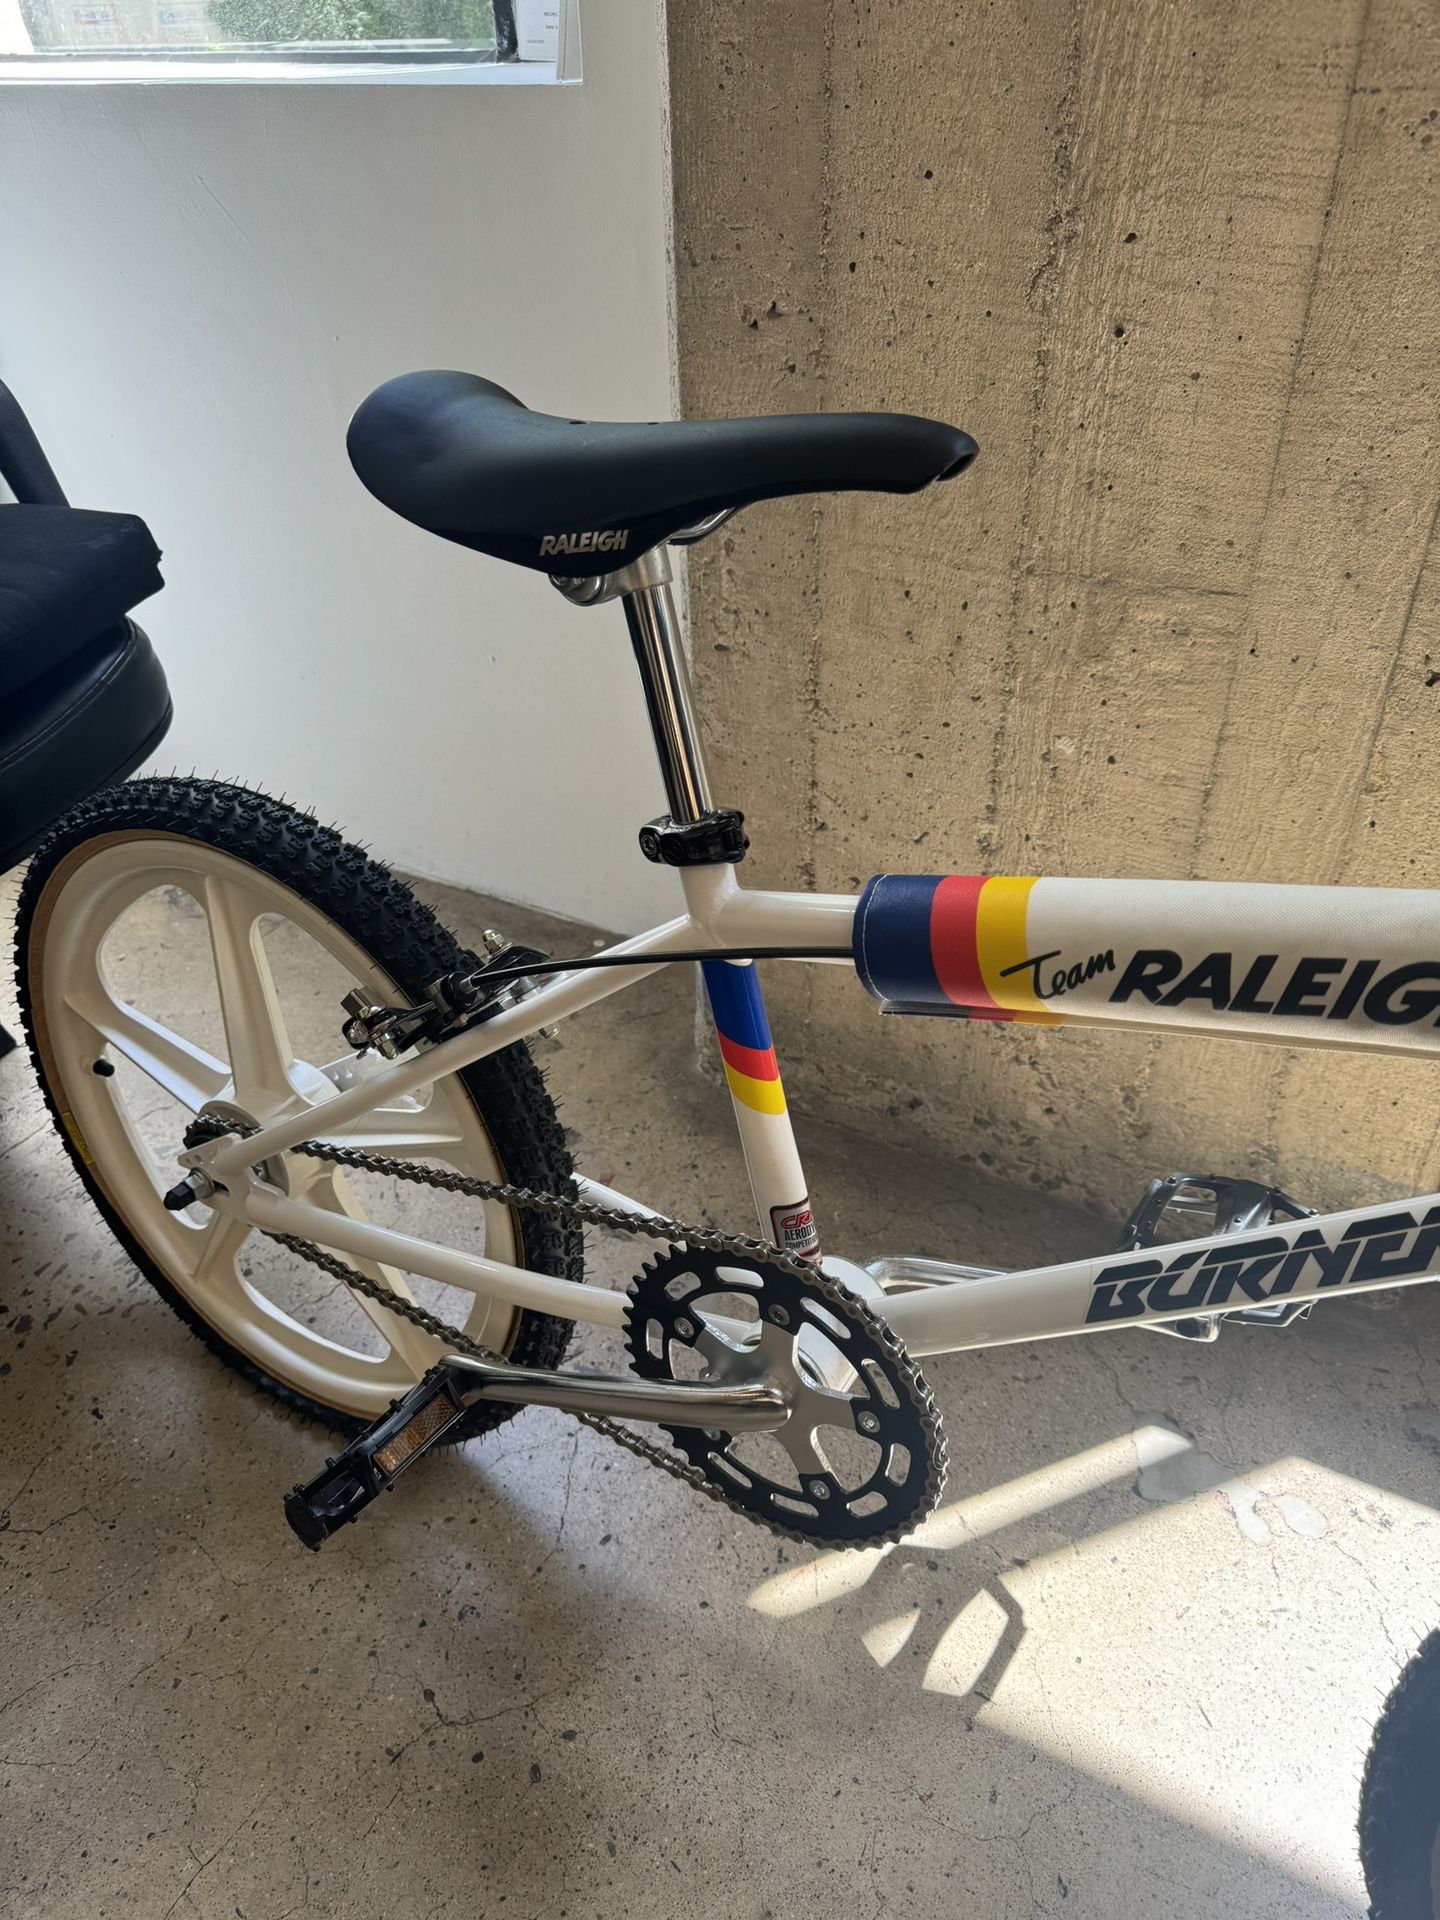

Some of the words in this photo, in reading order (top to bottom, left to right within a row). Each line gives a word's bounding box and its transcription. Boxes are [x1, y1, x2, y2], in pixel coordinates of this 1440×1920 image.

[540, 529, 629, 556] RALEIGH
[1000, 949, 1116, 1000] Team
[1108, 949, 1440, 1028] RALEIG
